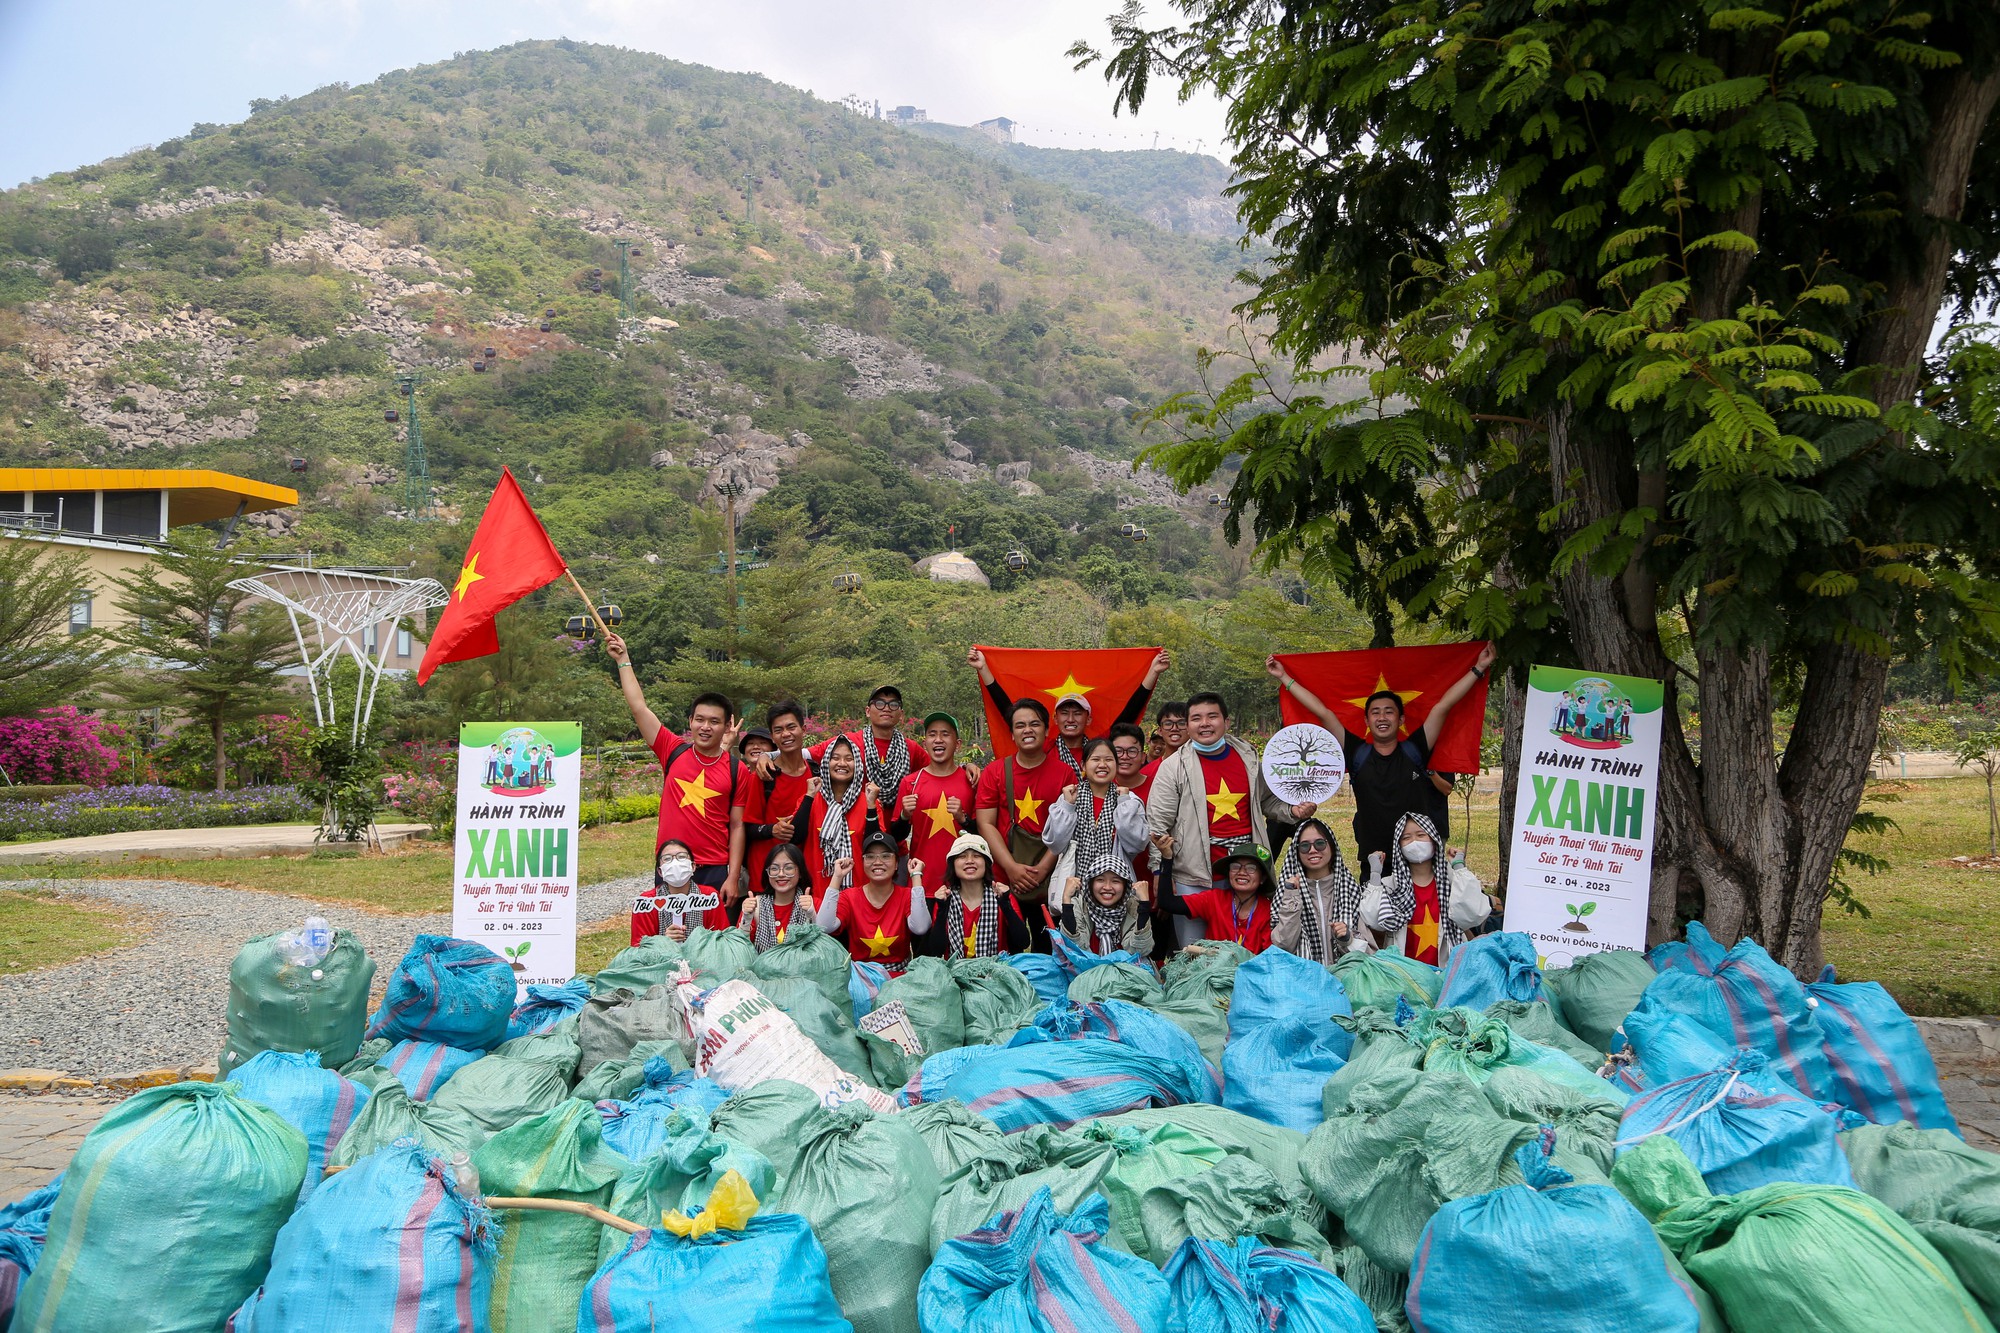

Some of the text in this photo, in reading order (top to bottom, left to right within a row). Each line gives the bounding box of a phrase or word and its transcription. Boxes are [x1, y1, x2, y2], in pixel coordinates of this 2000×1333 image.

[1535, 749, 1643, 777] HÀNH TRÌNH
[1270, 765, 1341, 779] Xanh Vietnam
[469, 801, 566, 819] HÀNH TRÌNH
[1525, 774, 1645, 840] XANH
[464, 828, 569, 878] XANH
[1523, 831, 1644, 862] Huyền Thoại Núi Thiêng
[1538, 851, 1624, 875] Sức Trẻ Anh Tài
[494, 883, 518, 897] Thoại
[520, 883, 538, 894] Núi
[541, 883, 570, 897] Thiêng
[1544, 875, 1557, 884] 02
[1565, 878, 1577, 887] 04
[1586, 881, 1611, 892] 2023
[477, 900, 553, 912] Sức Trẻ Anh Tài
[634, 893, 718, 914] Tôi Tây Ninh
[484, 923, 495, 931] 02
[502, 923, 514, 931] 04
[520, 922, 543, 931] 2023
[1540, 934, 1560, 943] ĐƠN
[1562, 937, 1571, 946] VỊ
[1572, 936, 1599, 949] ĐỒNG
[537, 976, 549, 985] TÀI
